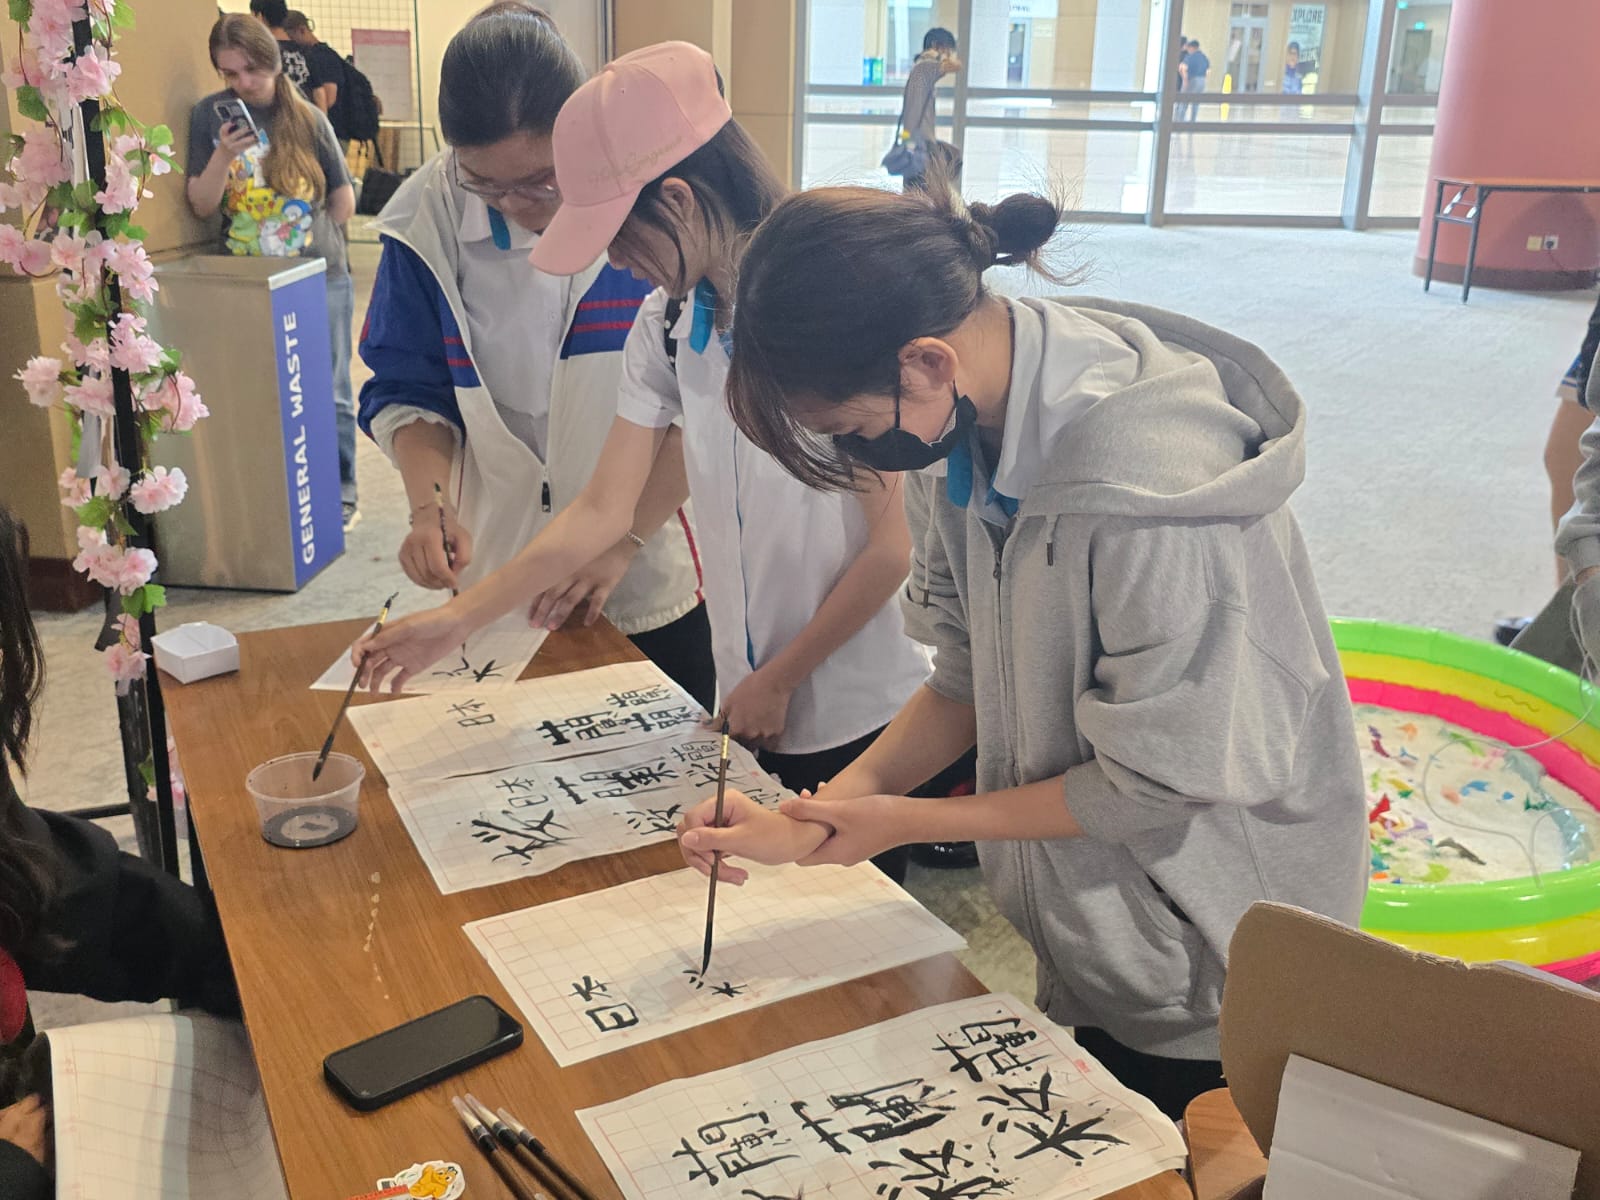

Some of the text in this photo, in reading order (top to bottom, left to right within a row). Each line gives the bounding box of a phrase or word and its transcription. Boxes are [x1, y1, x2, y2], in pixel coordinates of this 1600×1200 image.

[283, 312, 315, 564] GENERAL WASTE
[446, 699, 496, 727] 日本
[496, 777, 549, 808] 日本
[568, 975, 638, 1032] 日本
